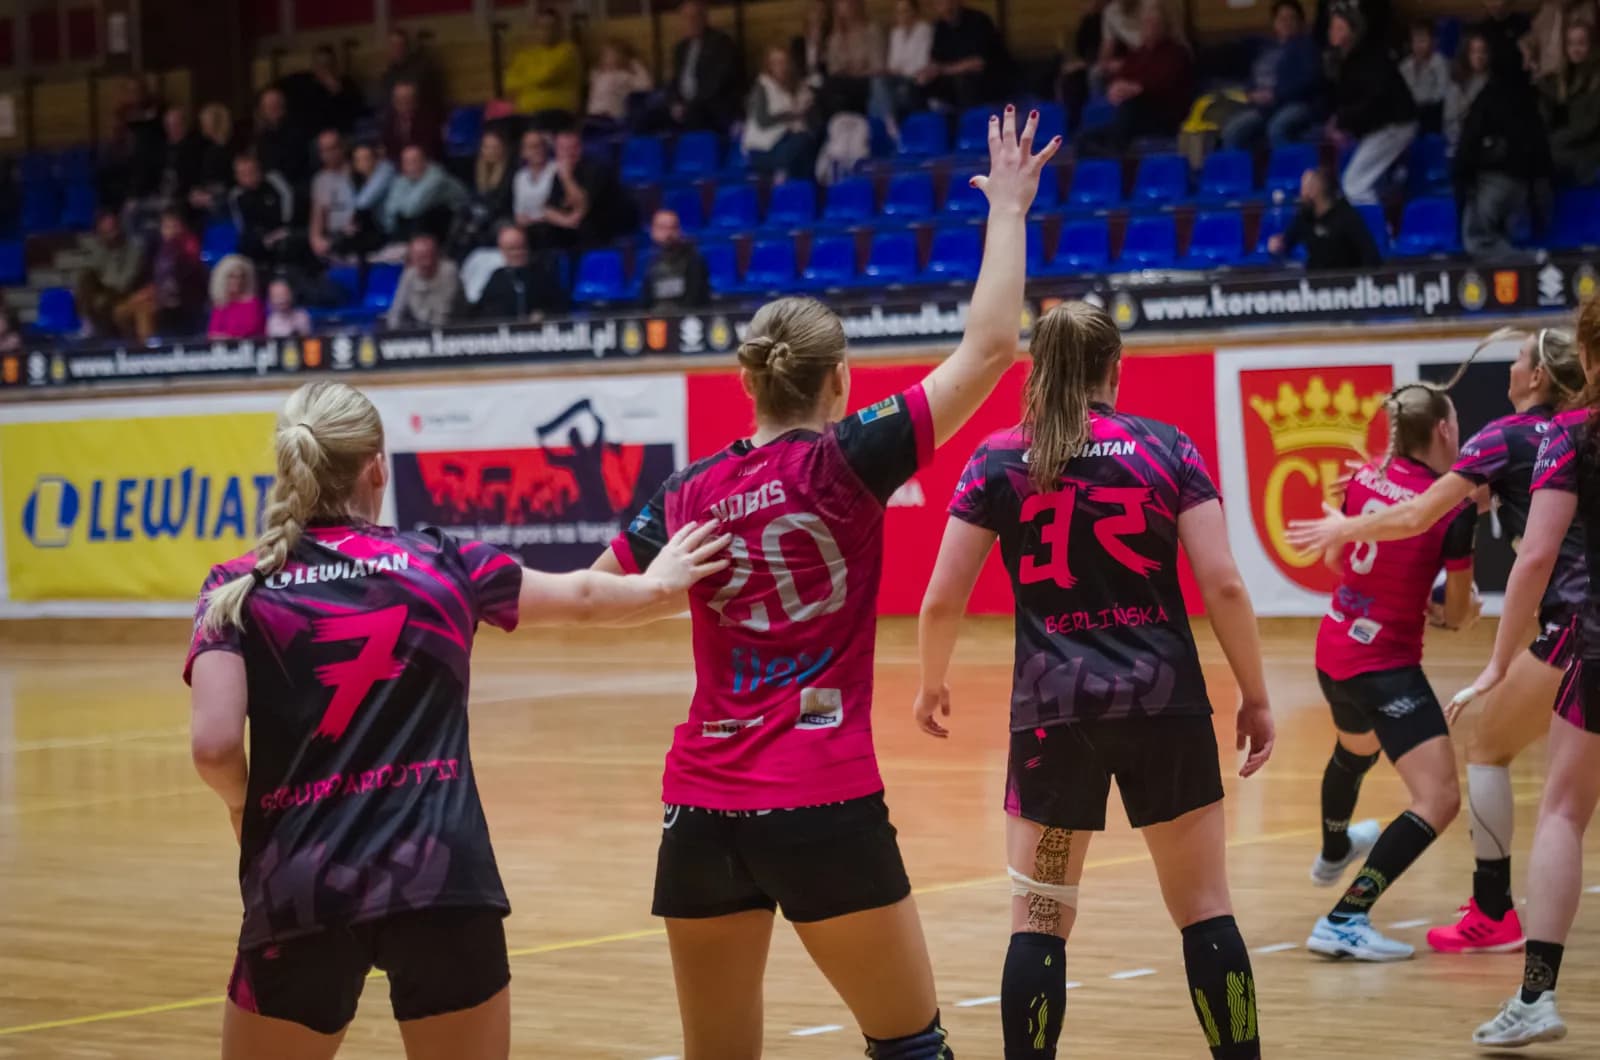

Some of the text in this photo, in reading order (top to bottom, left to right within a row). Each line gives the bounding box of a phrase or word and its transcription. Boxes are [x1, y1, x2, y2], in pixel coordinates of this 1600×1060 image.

[1144, 274, 1449, 321] www.koronahandball.pl
[87, 467, 278, 541] LEWIAT
[710, 479, 787, 523] NOBIS
[295, 552, 409, 585] LEWIATAN
[706, 512, 848, 632] 20
[1045, 601, 1168, 634] BERLIŃSKA
[311, 604, 408, 742] 7
